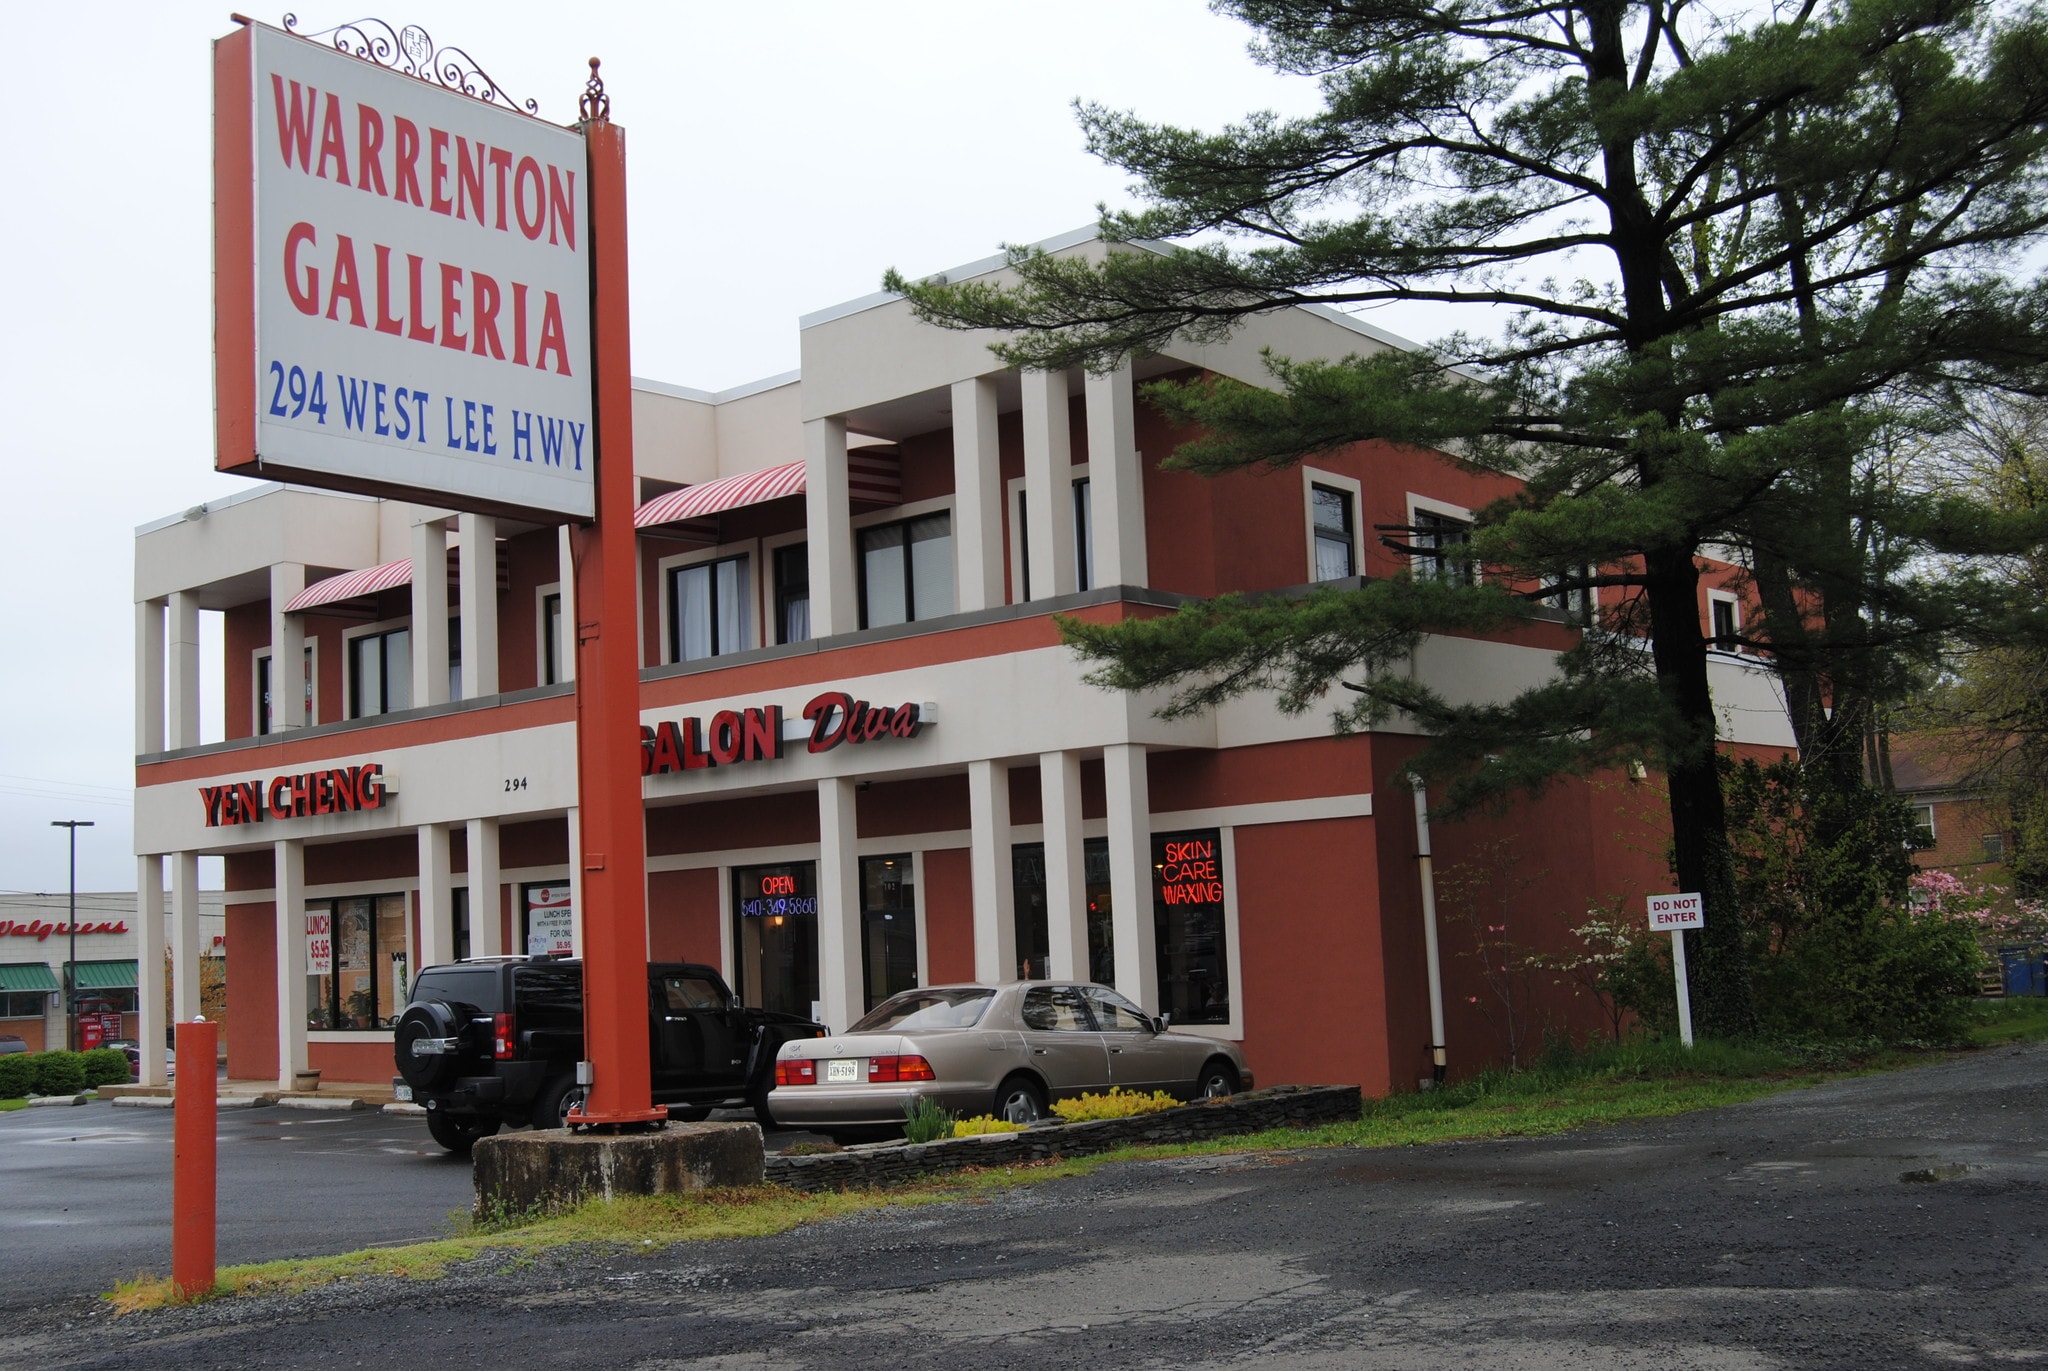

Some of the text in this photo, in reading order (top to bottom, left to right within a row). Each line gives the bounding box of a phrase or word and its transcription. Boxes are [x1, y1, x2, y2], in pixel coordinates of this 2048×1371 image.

[271, 73, 575, 252] WARRENTON
[283, 222, 573, 377] GALLERIA
[269, 360, 585, 471] 294 WEST LEE HWY
[803, 691, 920, 754] Diva
[504, 777, 527, 792] 294
[199, 763, 386, 827] YEN CHENG
[1165, 840, 1211, 863] SKIN
[1163, 860, 1218, 882] CARE
[762, 875, 795, 895] OPEN
[1162, 882, 1222, 905] WAXING
[543, 910, 560, 919] LUNCH
[741, 896, 817, 917] 540-349-5860
[1653, 899, 1697, 911] DO NOT
[306, 915, 330, 935] LUNCH
[1657, 912, 1696, 923] ENTER
[550, 930, 560, 938] FOR
[311, 939, 330, 958] $5.95
[556, 941, 571, 949] $5.95
